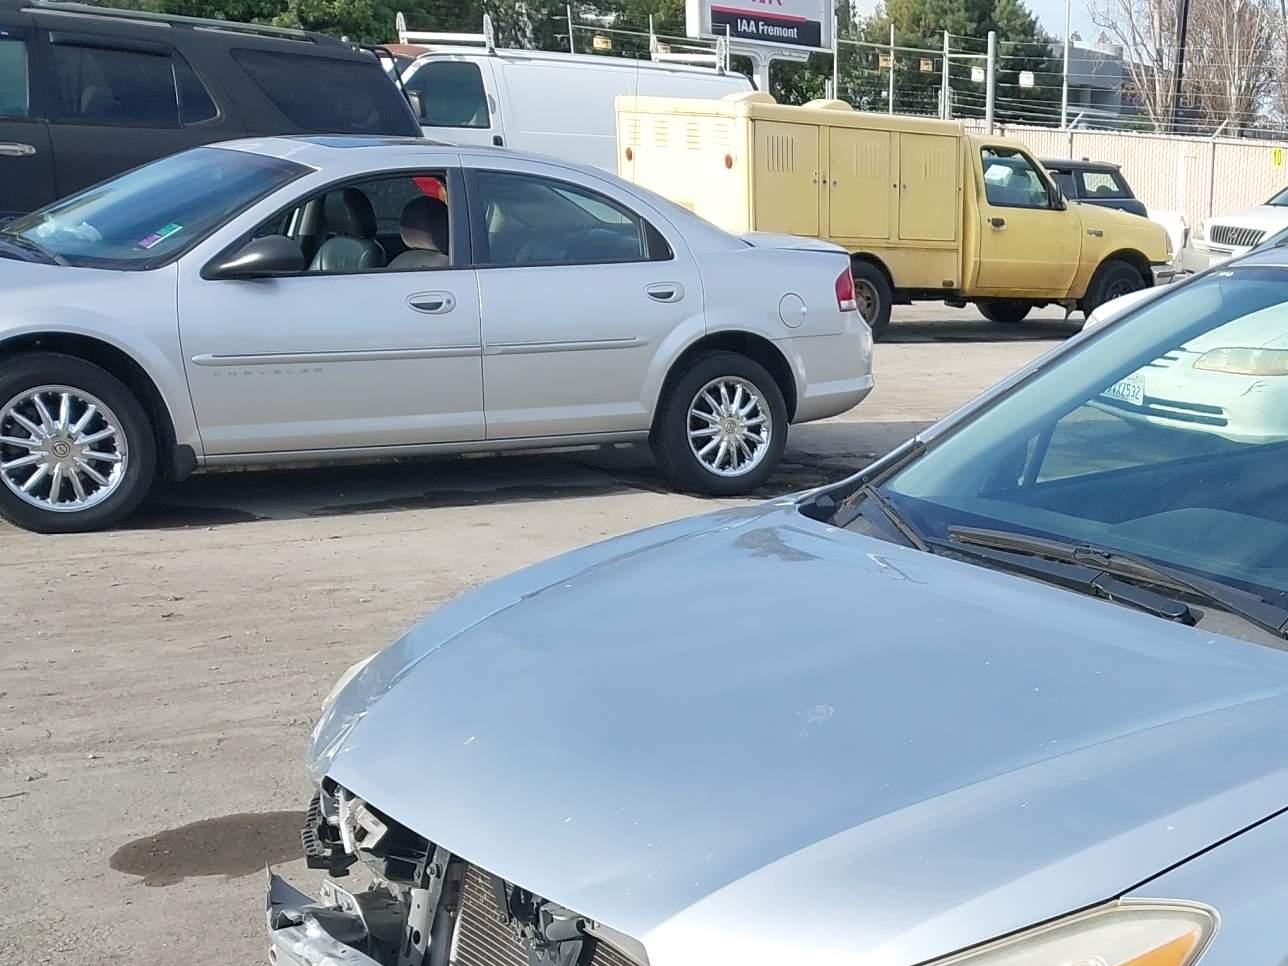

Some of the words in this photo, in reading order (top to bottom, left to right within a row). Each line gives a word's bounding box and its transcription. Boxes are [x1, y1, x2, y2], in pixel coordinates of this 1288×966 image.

[737, 18, 757, 34] IAA
[758, 21, 798, 39] Fremont
[1273, 148, 1282, 166] 10
